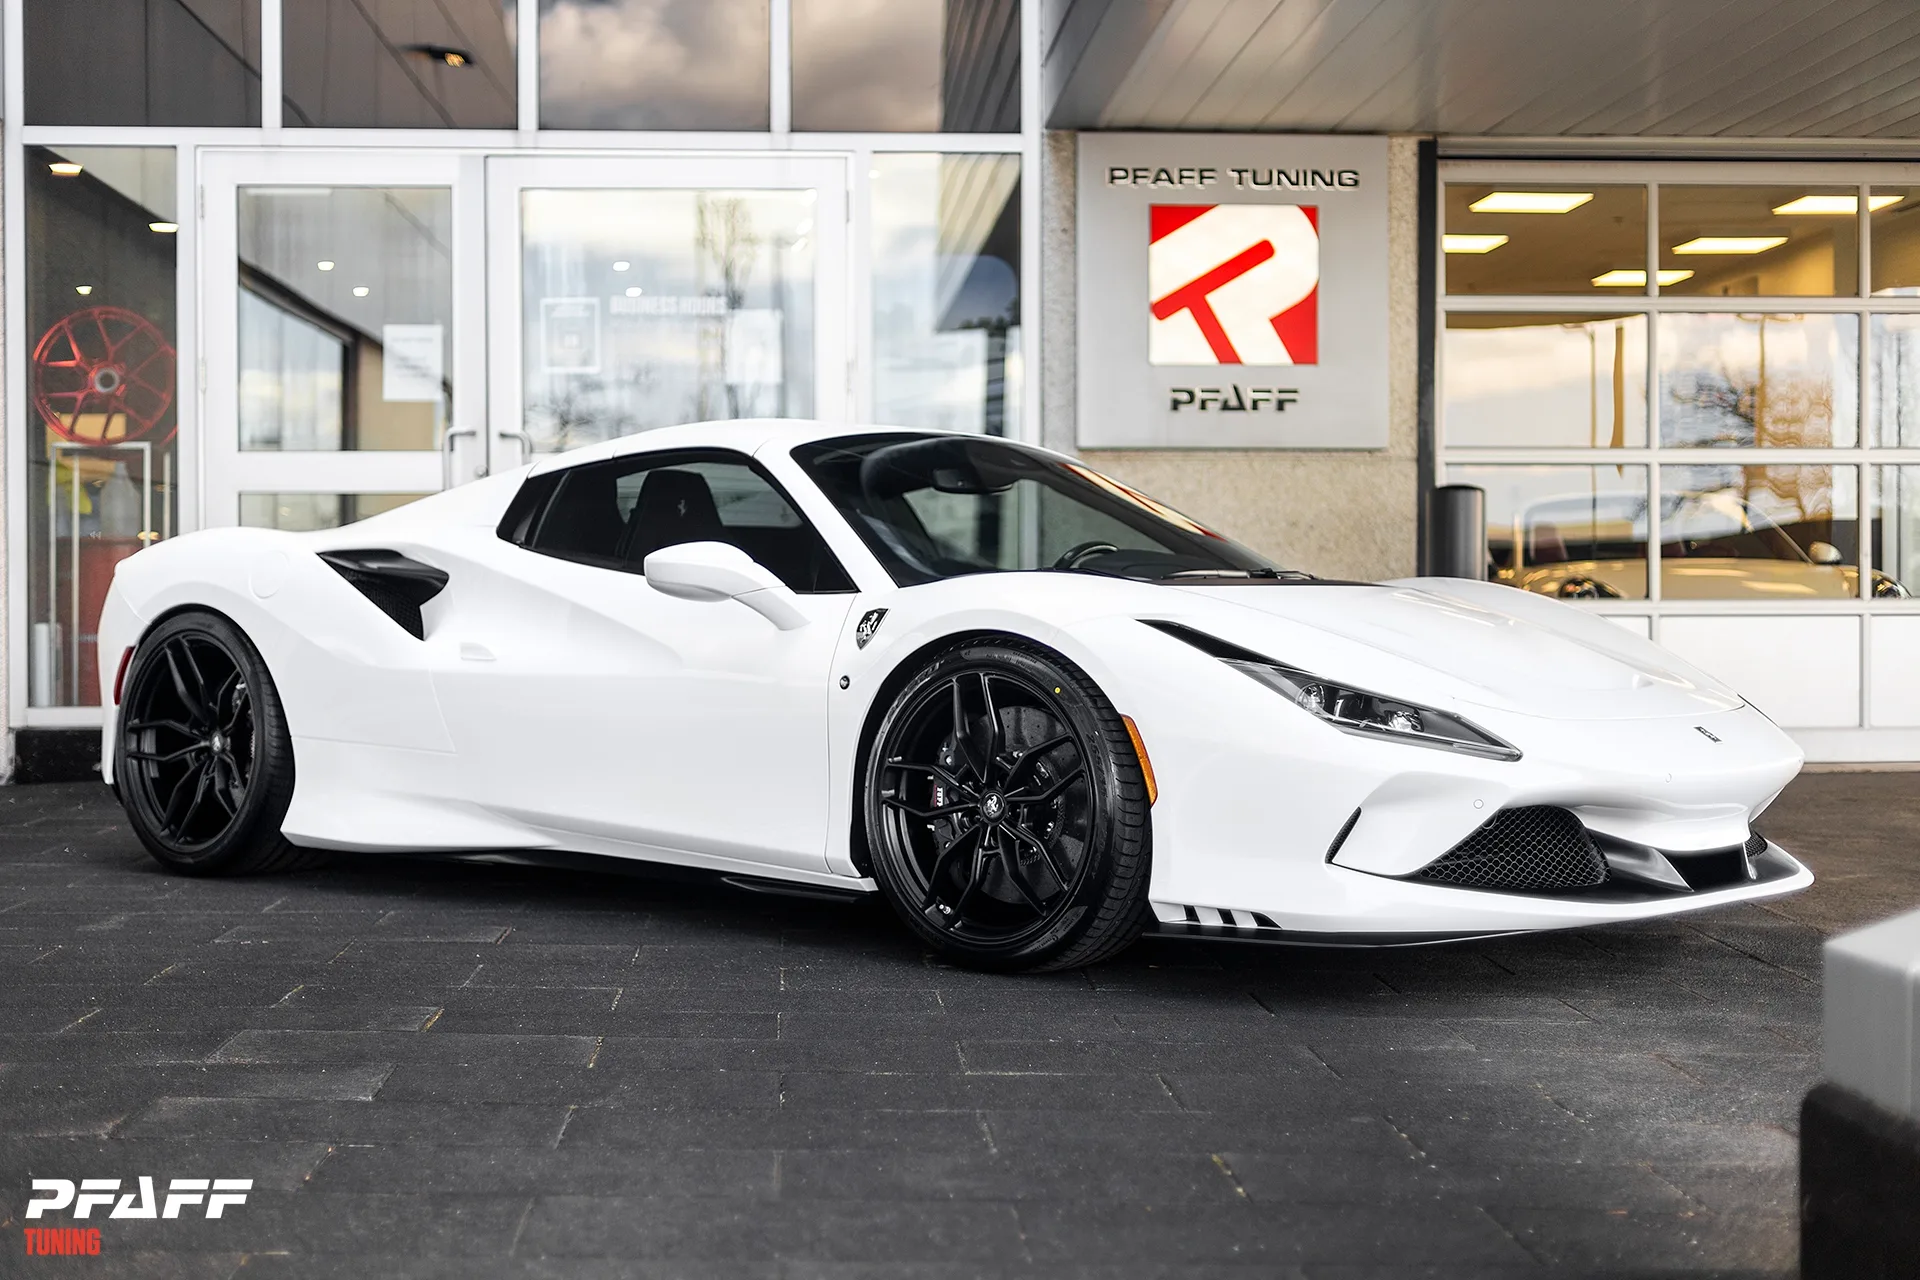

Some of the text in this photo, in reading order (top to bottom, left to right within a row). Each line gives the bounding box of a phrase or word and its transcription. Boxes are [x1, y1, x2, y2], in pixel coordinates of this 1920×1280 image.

[1108, 167, 1360, 189] PFAFF TUNING
[1170, 384, 1298, 411] PFAFF
